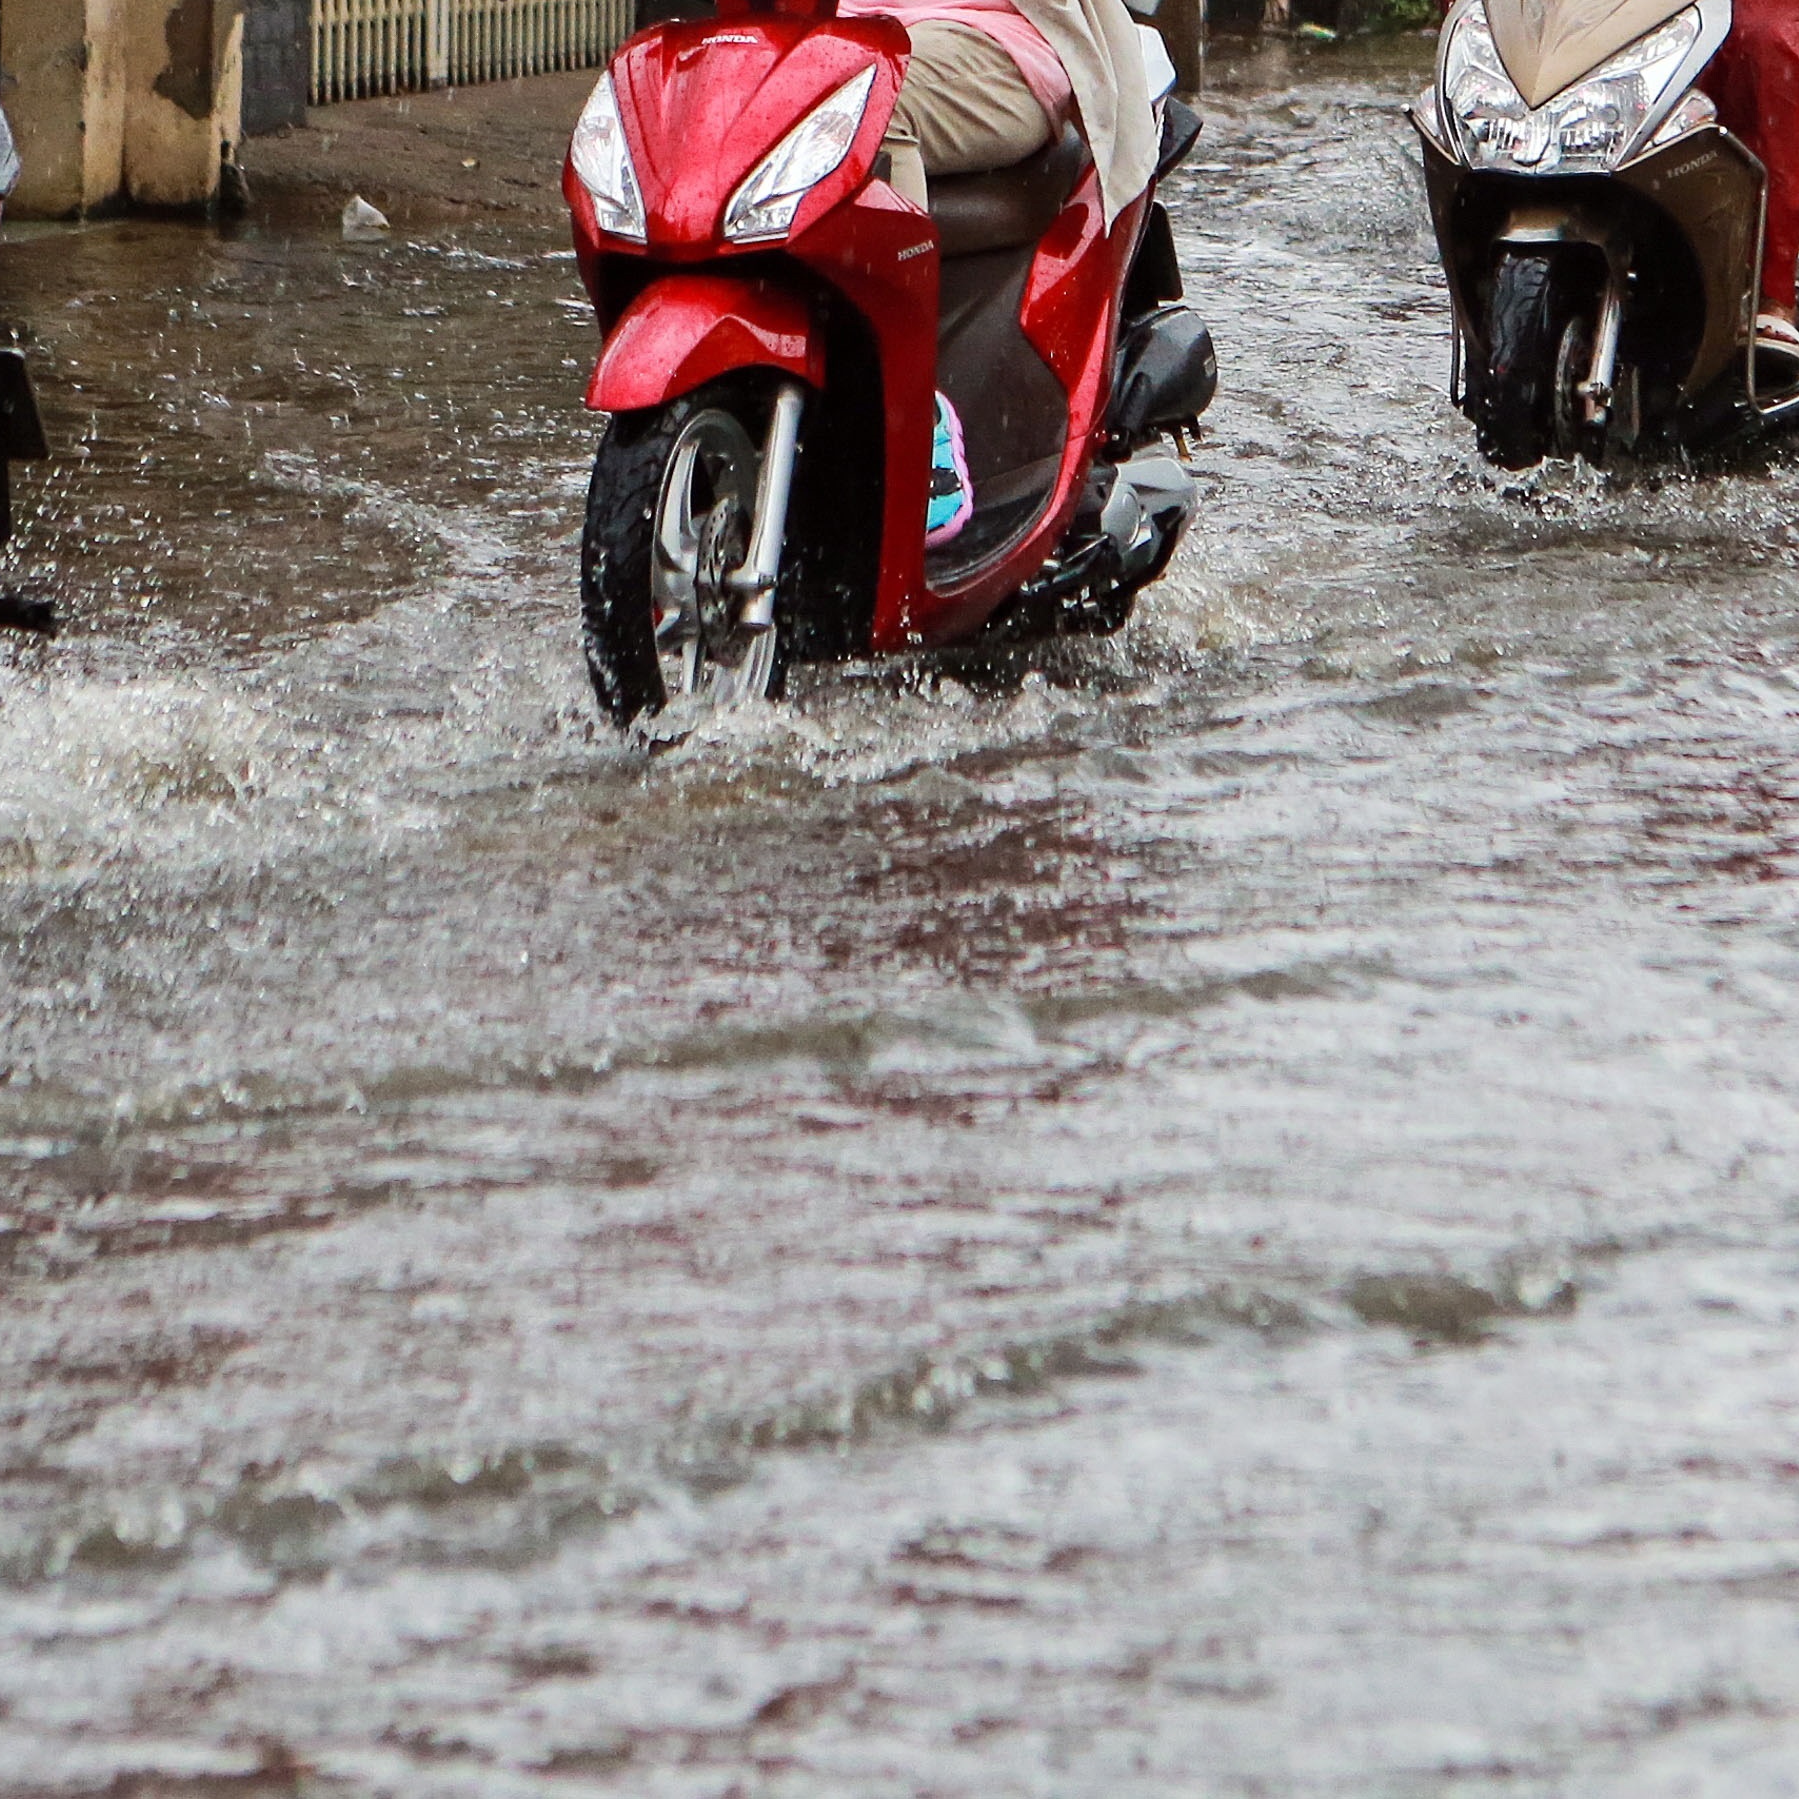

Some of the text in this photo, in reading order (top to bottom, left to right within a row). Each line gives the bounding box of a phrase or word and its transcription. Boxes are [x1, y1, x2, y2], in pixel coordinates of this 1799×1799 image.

[701, 34, 759, 45] HONDA
[1666, 150, 1718, 179] HONDA
[897, 239, 935, 262] HONDA
